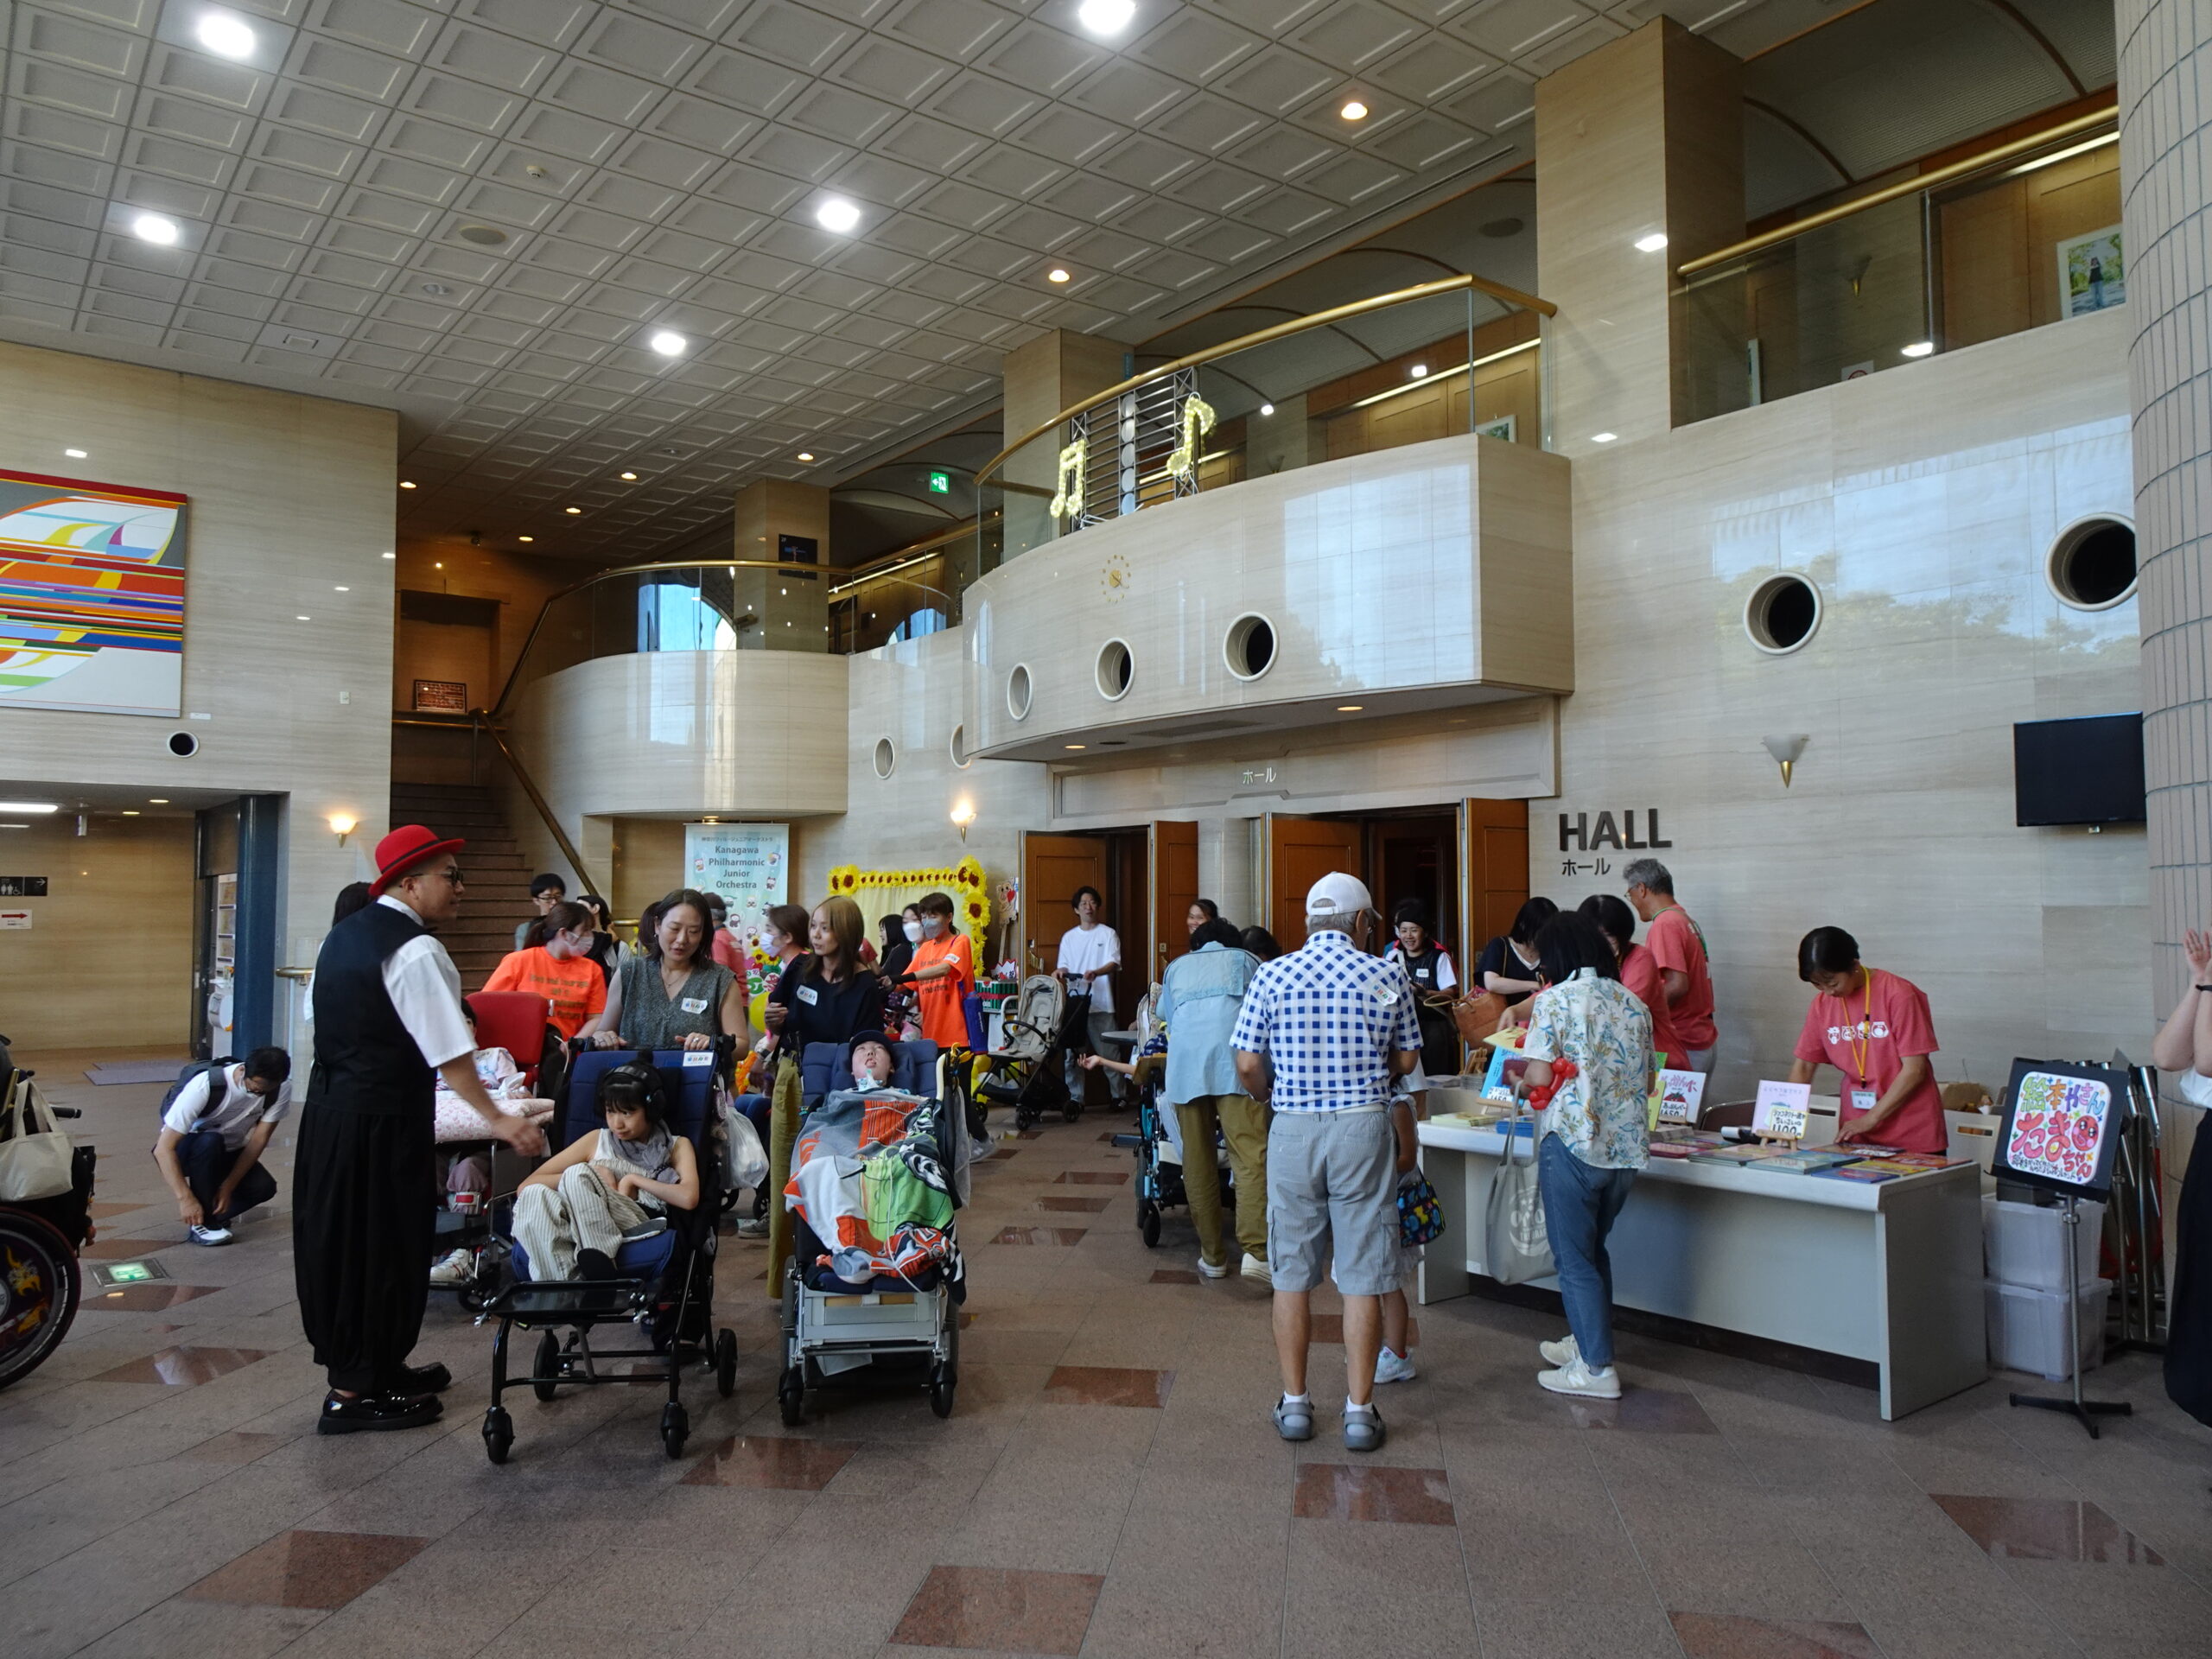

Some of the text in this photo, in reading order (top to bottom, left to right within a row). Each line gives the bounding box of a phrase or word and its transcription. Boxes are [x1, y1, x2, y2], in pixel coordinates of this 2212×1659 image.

[1243, 767, 1277, 785] ホール
[1559, 808, 1672, 851] HALL
[715, 846, 759, 855] Kanagawa
[1561, 857, 1611, 876] ホール
